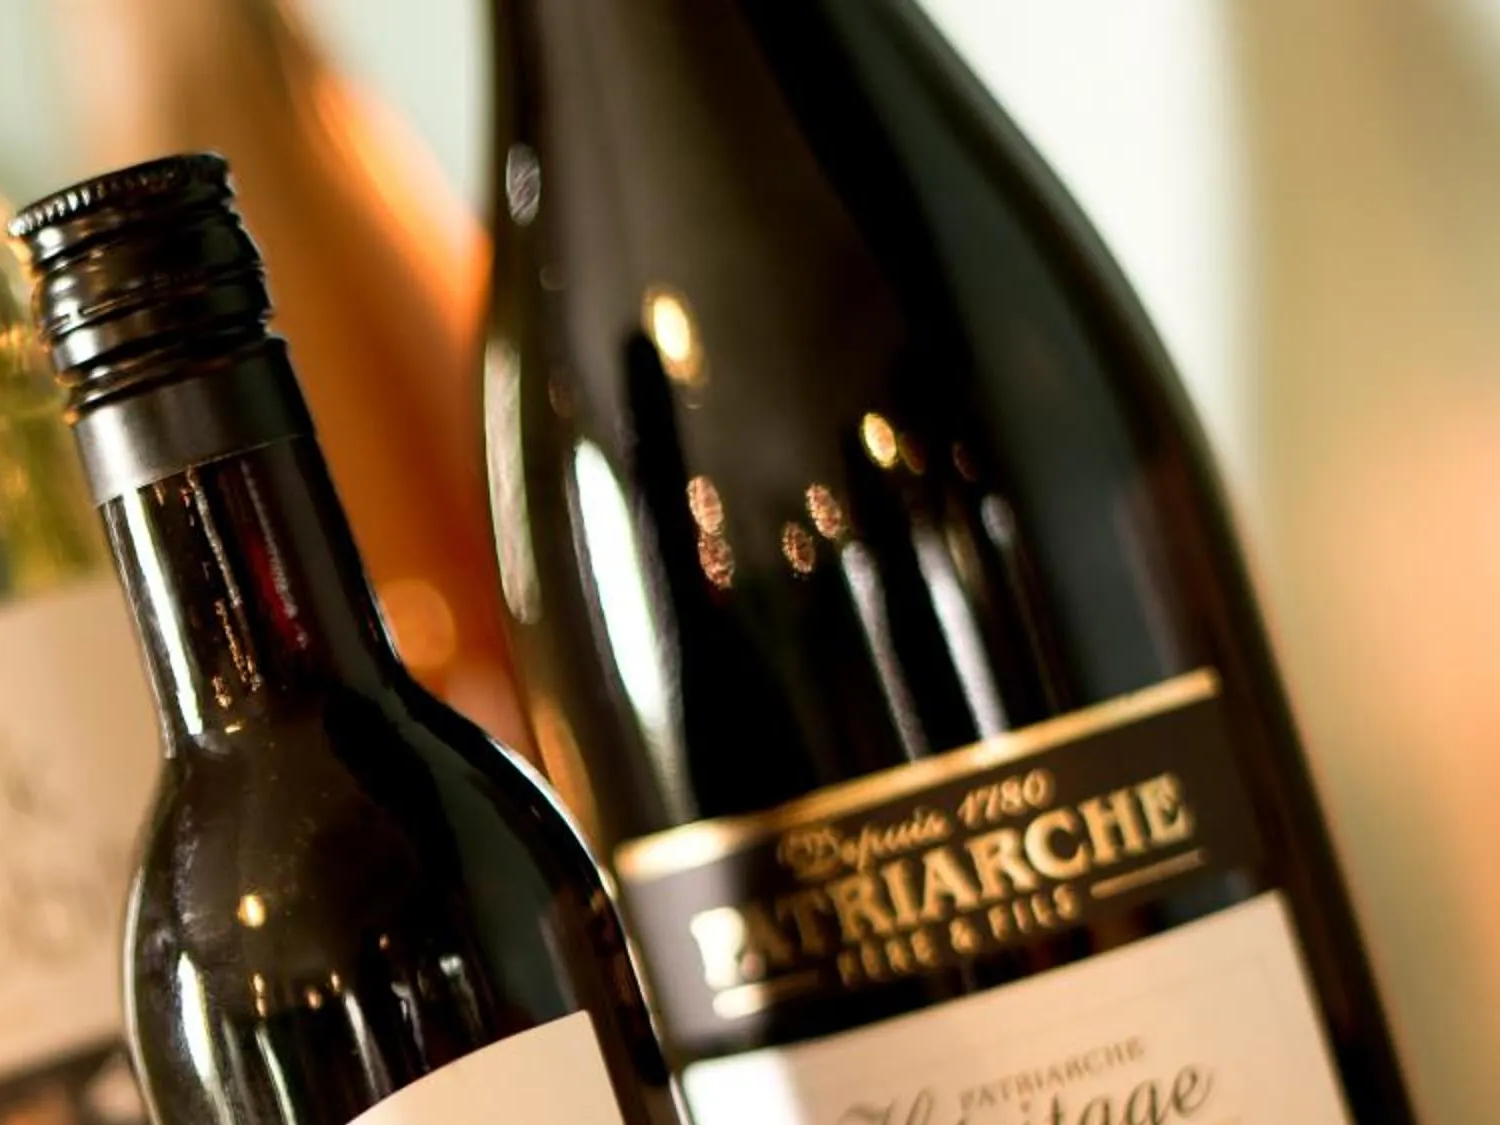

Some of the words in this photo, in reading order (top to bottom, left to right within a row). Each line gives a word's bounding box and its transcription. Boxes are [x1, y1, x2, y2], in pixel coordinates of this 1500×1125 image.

[957, 768, 1054, 826] 1780
[690, 772, 1197, 990] PATRIARCHE
[958, 1035, 1147, 1110] PATRIARCHE
